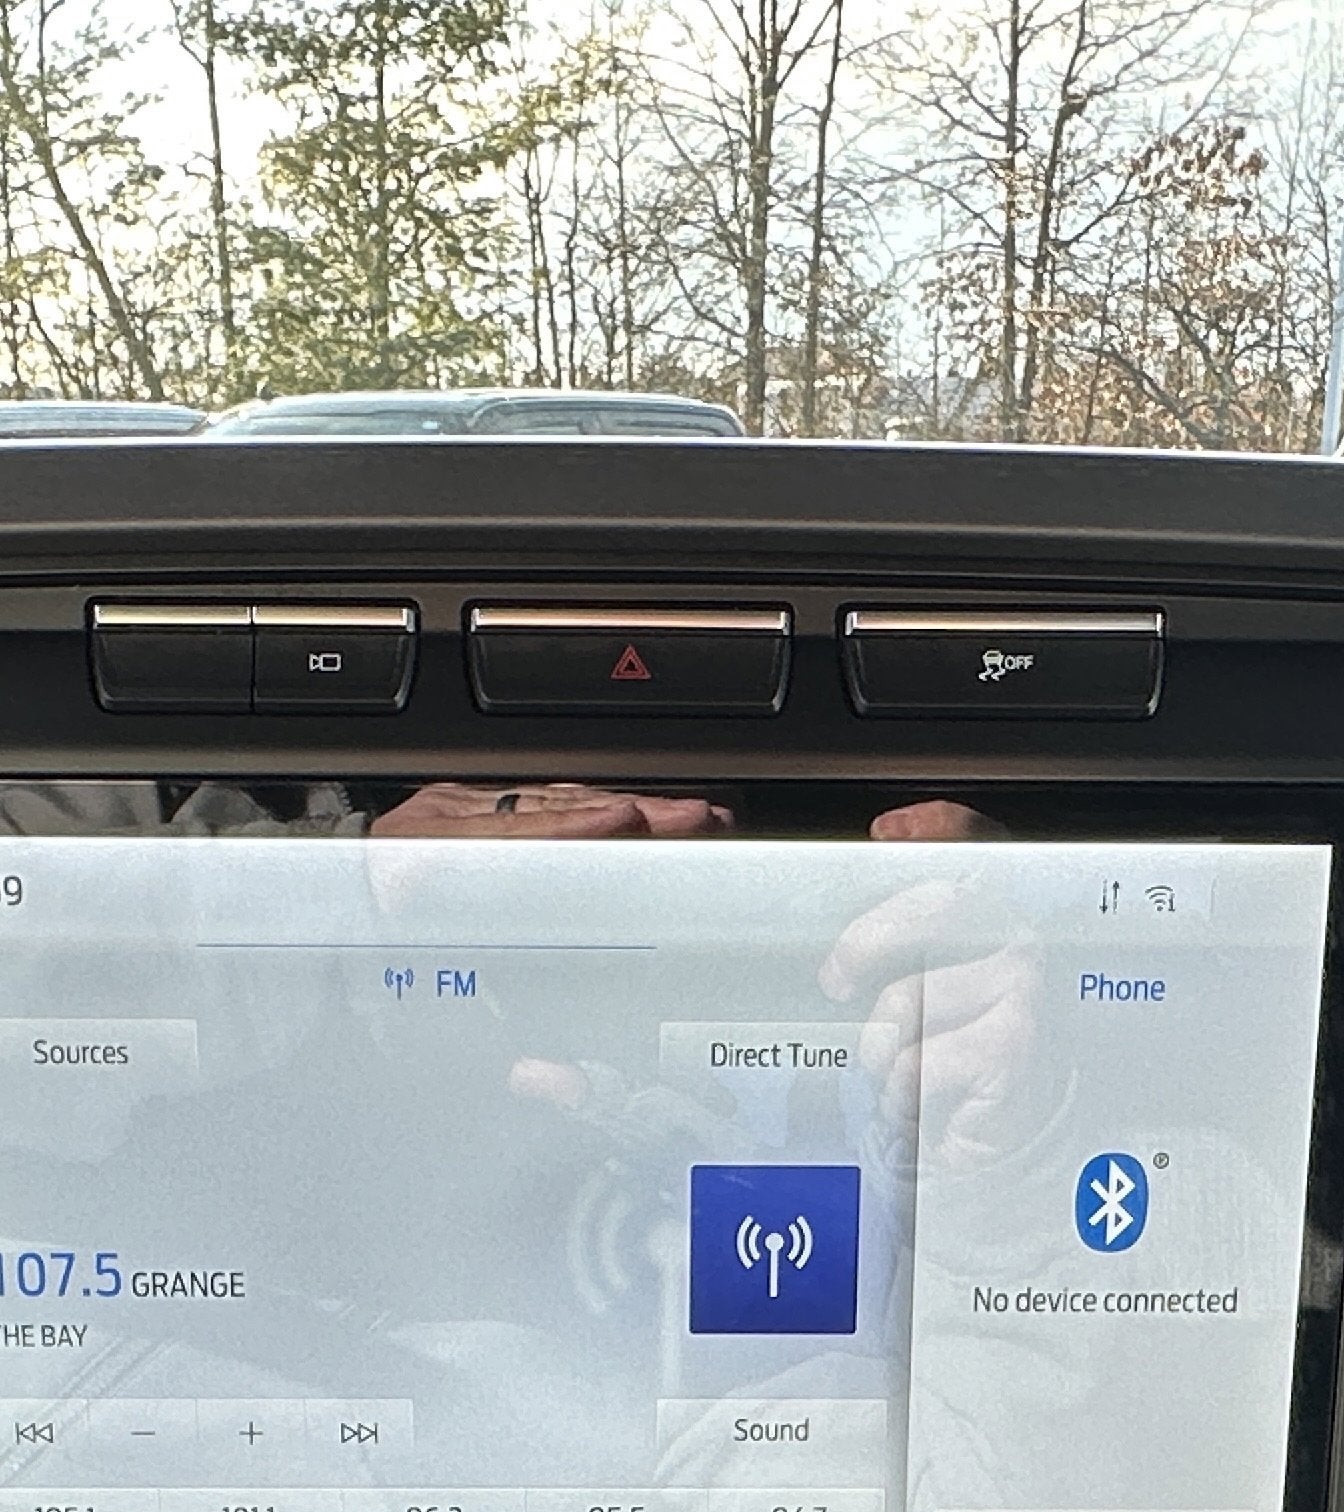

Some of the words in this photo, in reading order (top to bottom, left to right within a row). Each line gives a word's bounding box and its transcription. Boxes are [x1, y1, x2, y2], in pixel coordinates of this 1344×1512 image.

[1004, 654, 1034, 671] OFF
[437, 970, 476, 998] FM
[1080, 972, 1166, 1002] Phone
[32, 1039, 129, 1065] Sources
[710, 1042, 782, 1068] Direct
[786, 1042, 848, 1068] Tune
[132, 1271, 246, 1298] GRANGE
[974, 1286, 1009, 1313] No
[1015, 1286, 1098, 1313] device
[1103, 1286, 1238, 1314] connected
[40, 1324, 88, 1348] BAY
[734, 1418, 810, 1442] Sound
